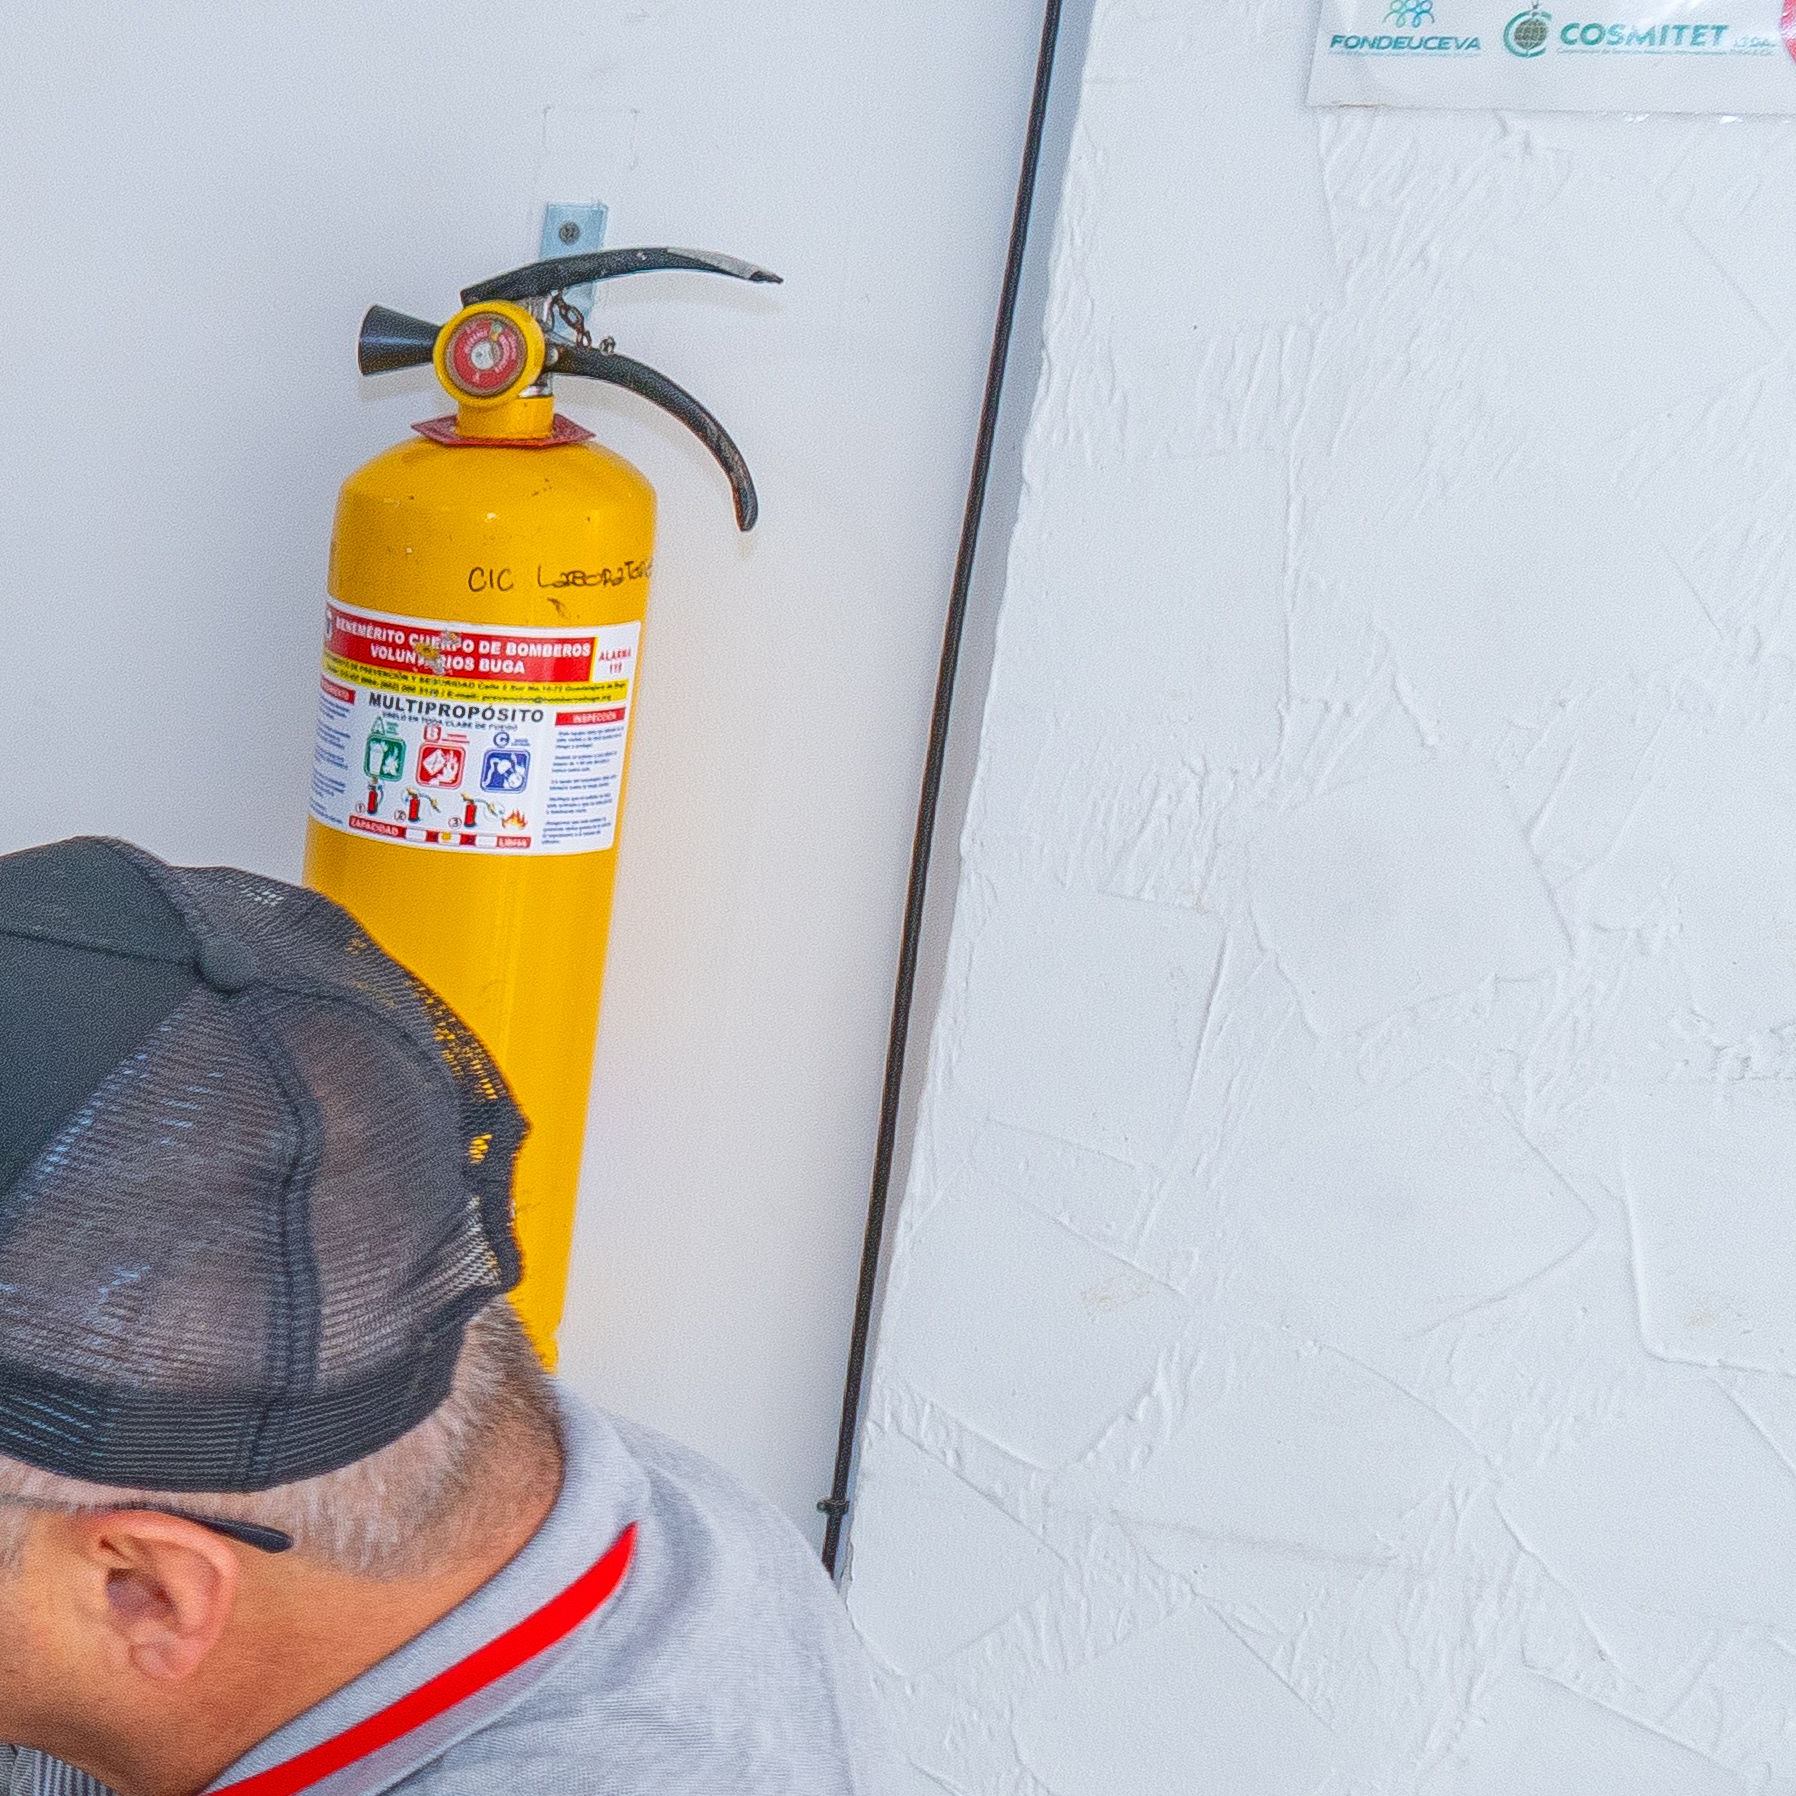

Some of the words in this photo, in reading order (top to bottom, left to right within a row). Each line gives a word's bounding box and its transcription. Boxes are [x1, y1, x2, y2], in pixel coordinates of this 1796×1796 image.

[1330, 35, 1482, 51] FONDEUCEVA
[1560, 22, 1729, 47] COSMITET
[468, 566, 514, 592] CIC
[478, 640, 501, 655] DE
[506, 642, 591, 658] BOMBEROS
[478, 658, 526, 674] BUGA
[369, 692, 544, 723] MULTIPROPÓSITO
